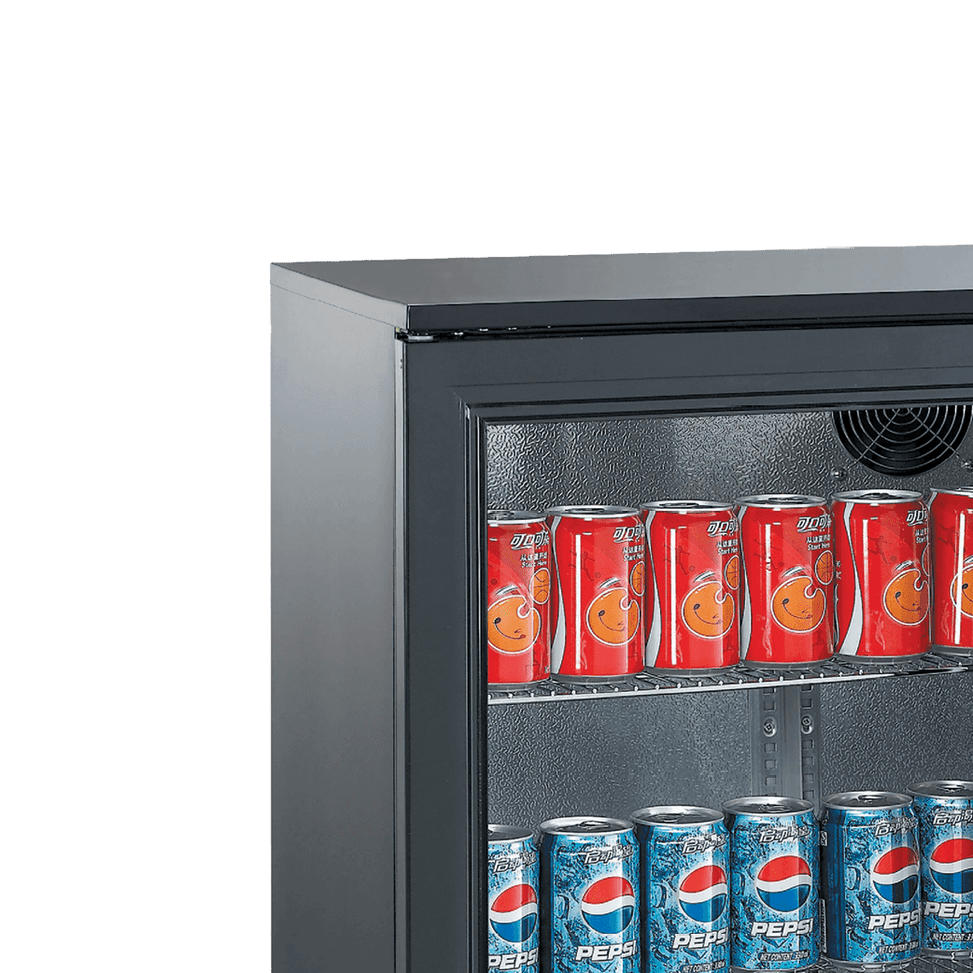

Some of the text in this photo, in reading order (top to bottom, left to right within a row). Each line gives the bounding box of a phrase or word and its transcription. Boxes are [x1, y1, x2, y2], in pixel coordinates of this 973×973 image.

[672, 926, 729, 949] PEPSI
[750, 917, 814, 938] PEPSI
[488, 947, 539, 970] PEPSI
[575, 940, 637, 962] PEPSI
